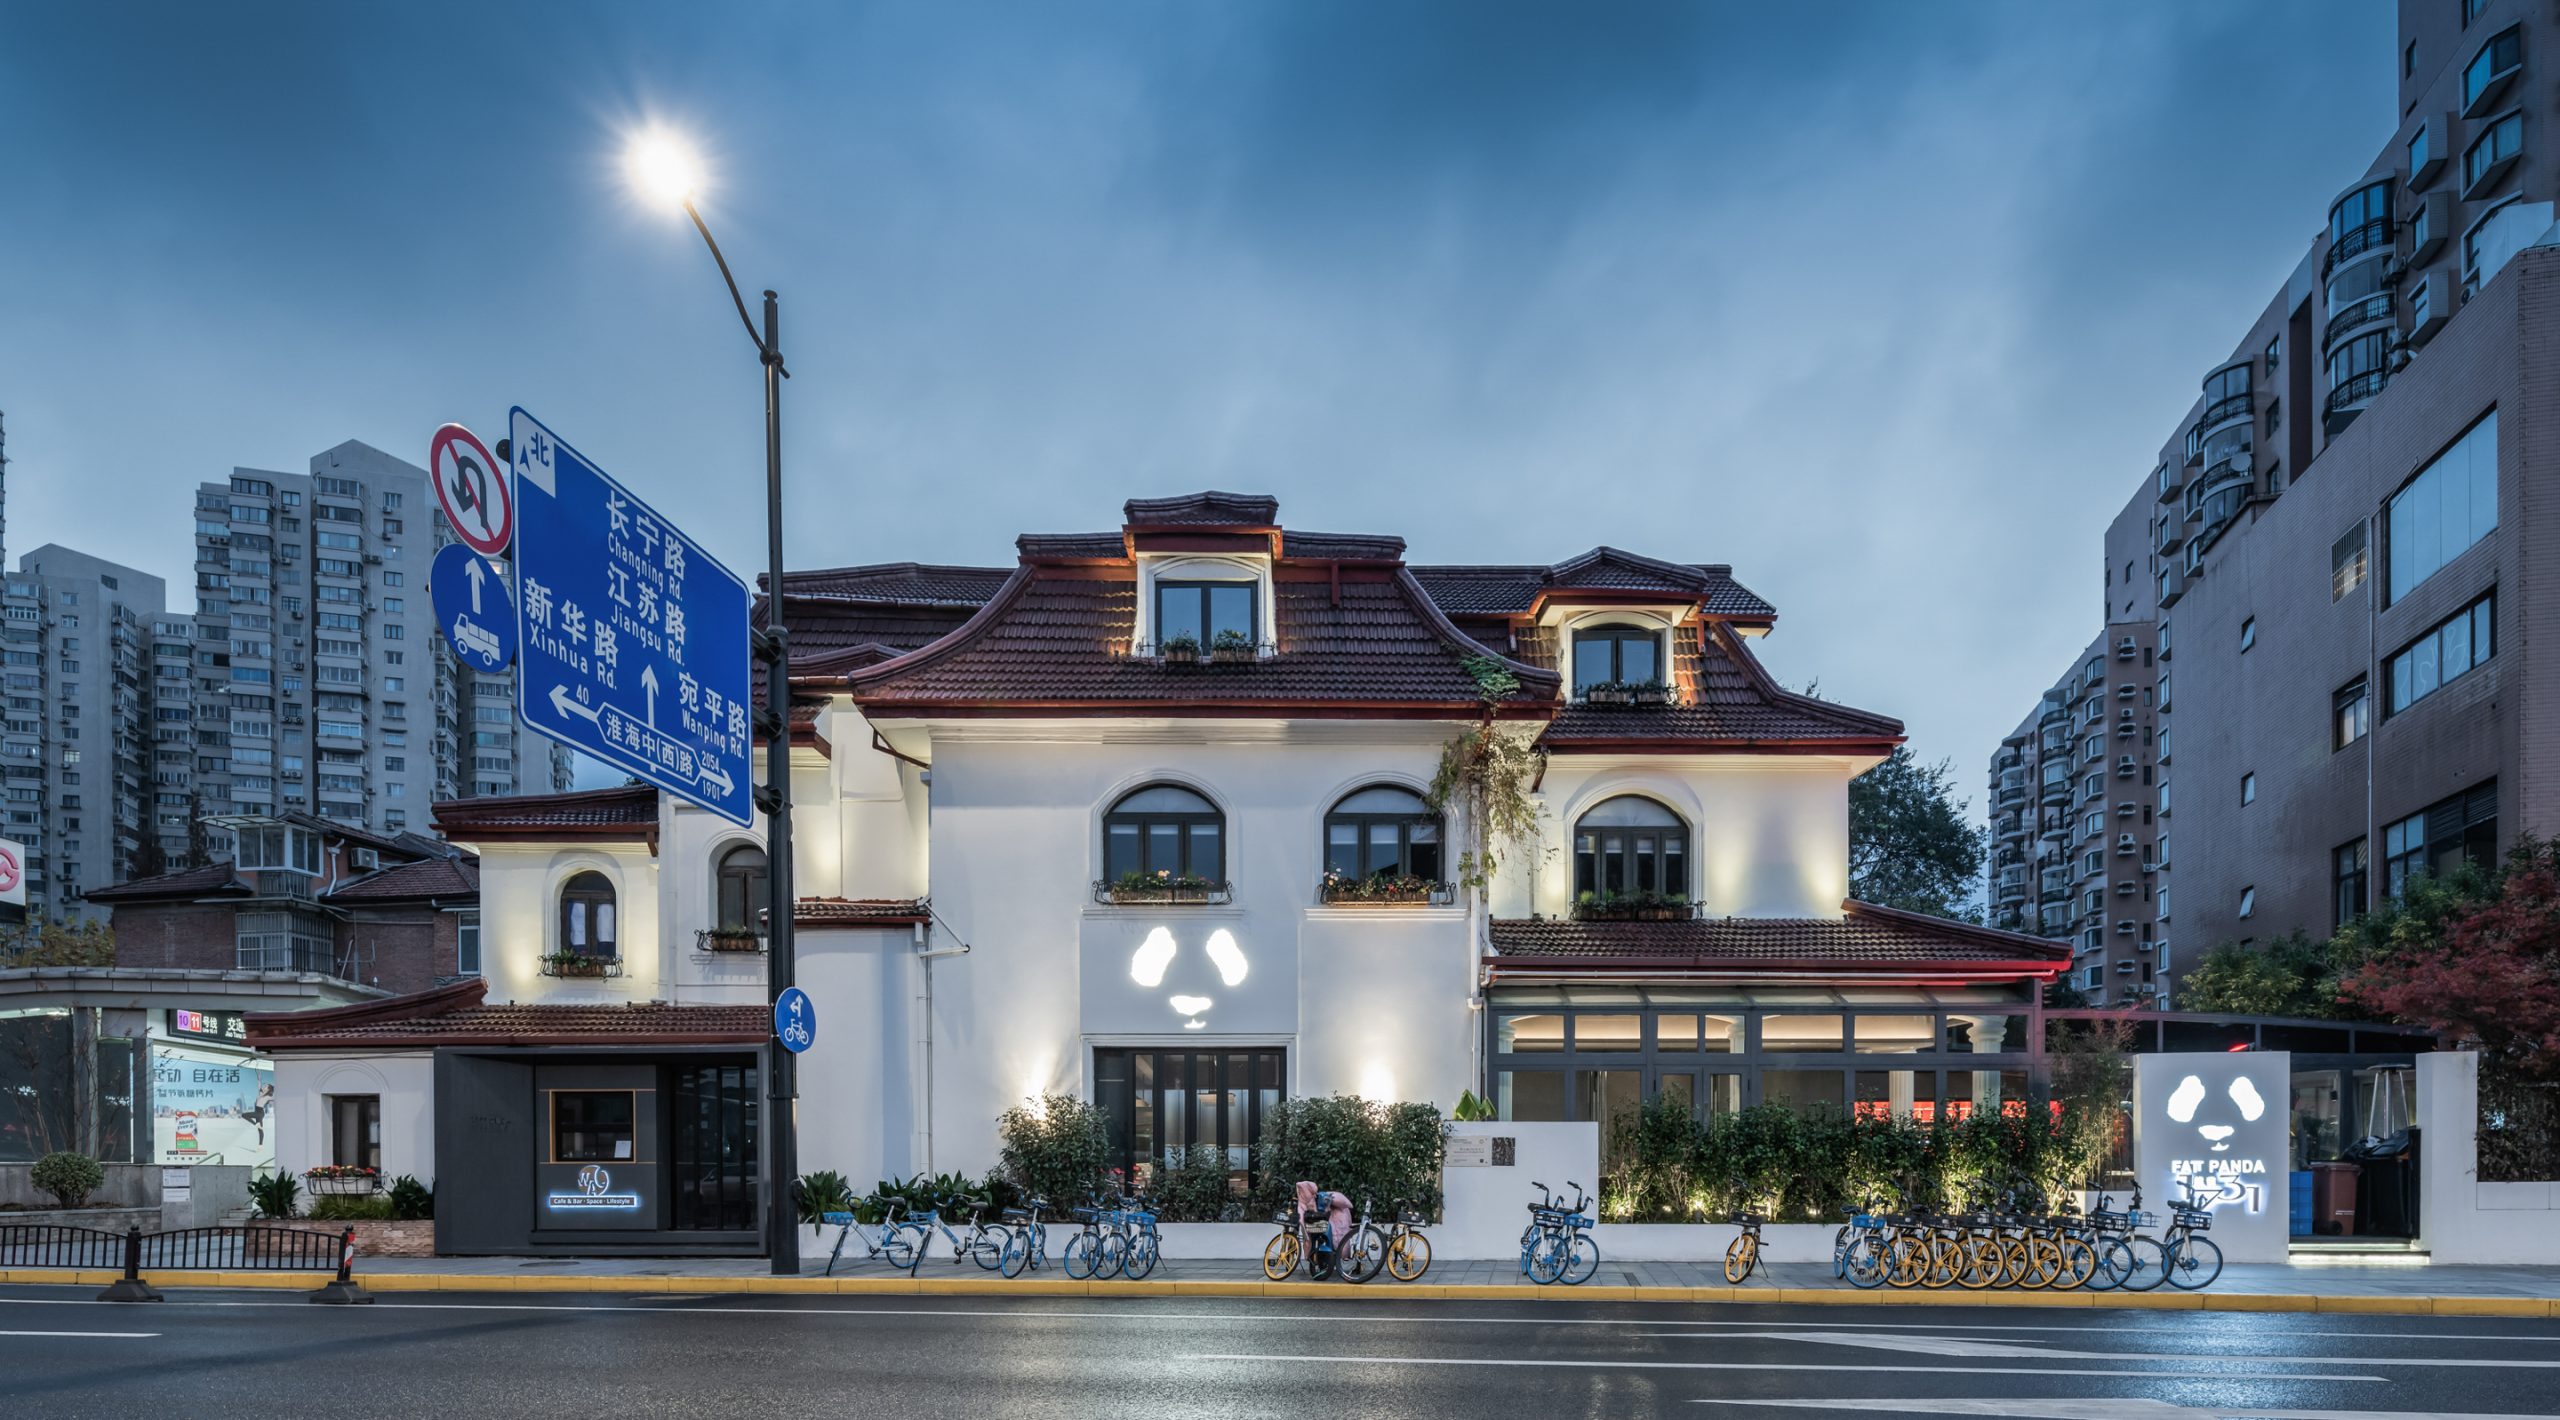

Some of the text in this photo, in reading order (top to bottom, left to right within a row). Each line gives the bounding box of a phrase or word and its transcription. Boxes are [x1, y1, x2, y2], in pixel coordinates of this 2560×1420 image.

[530, 432, 550, 467] 北
[606, 490, 686, 581] 长宁路
[608, 531, 683, 601] Changning Rd.
[524, 577, 619, 668] 新华路
[607, 561, 686, 645] 江苏路
[530, 622, 617, 691] Xinhua Rd.
[611, 604, 685, 667] Jiangsu Rd.
[576, 683, 590, 705] 40
[678, 671, 747, 741] 宛平路
[606, 711, 694, 778] 淮海中(西)路
[682, 708, 745, 760] Wanping Rd.
[701, 750, 720, 773] 2054
[702, 779, 720, 801] 1901
[179, 1015, 189, 1027] 10
[191, 1016, 200, 1029] 11
[203, 1016, 218, 1029] 号线
[193, 1069, 240, 1083] 自在活
[2208, 1160, 2266, 1174] PANDA
